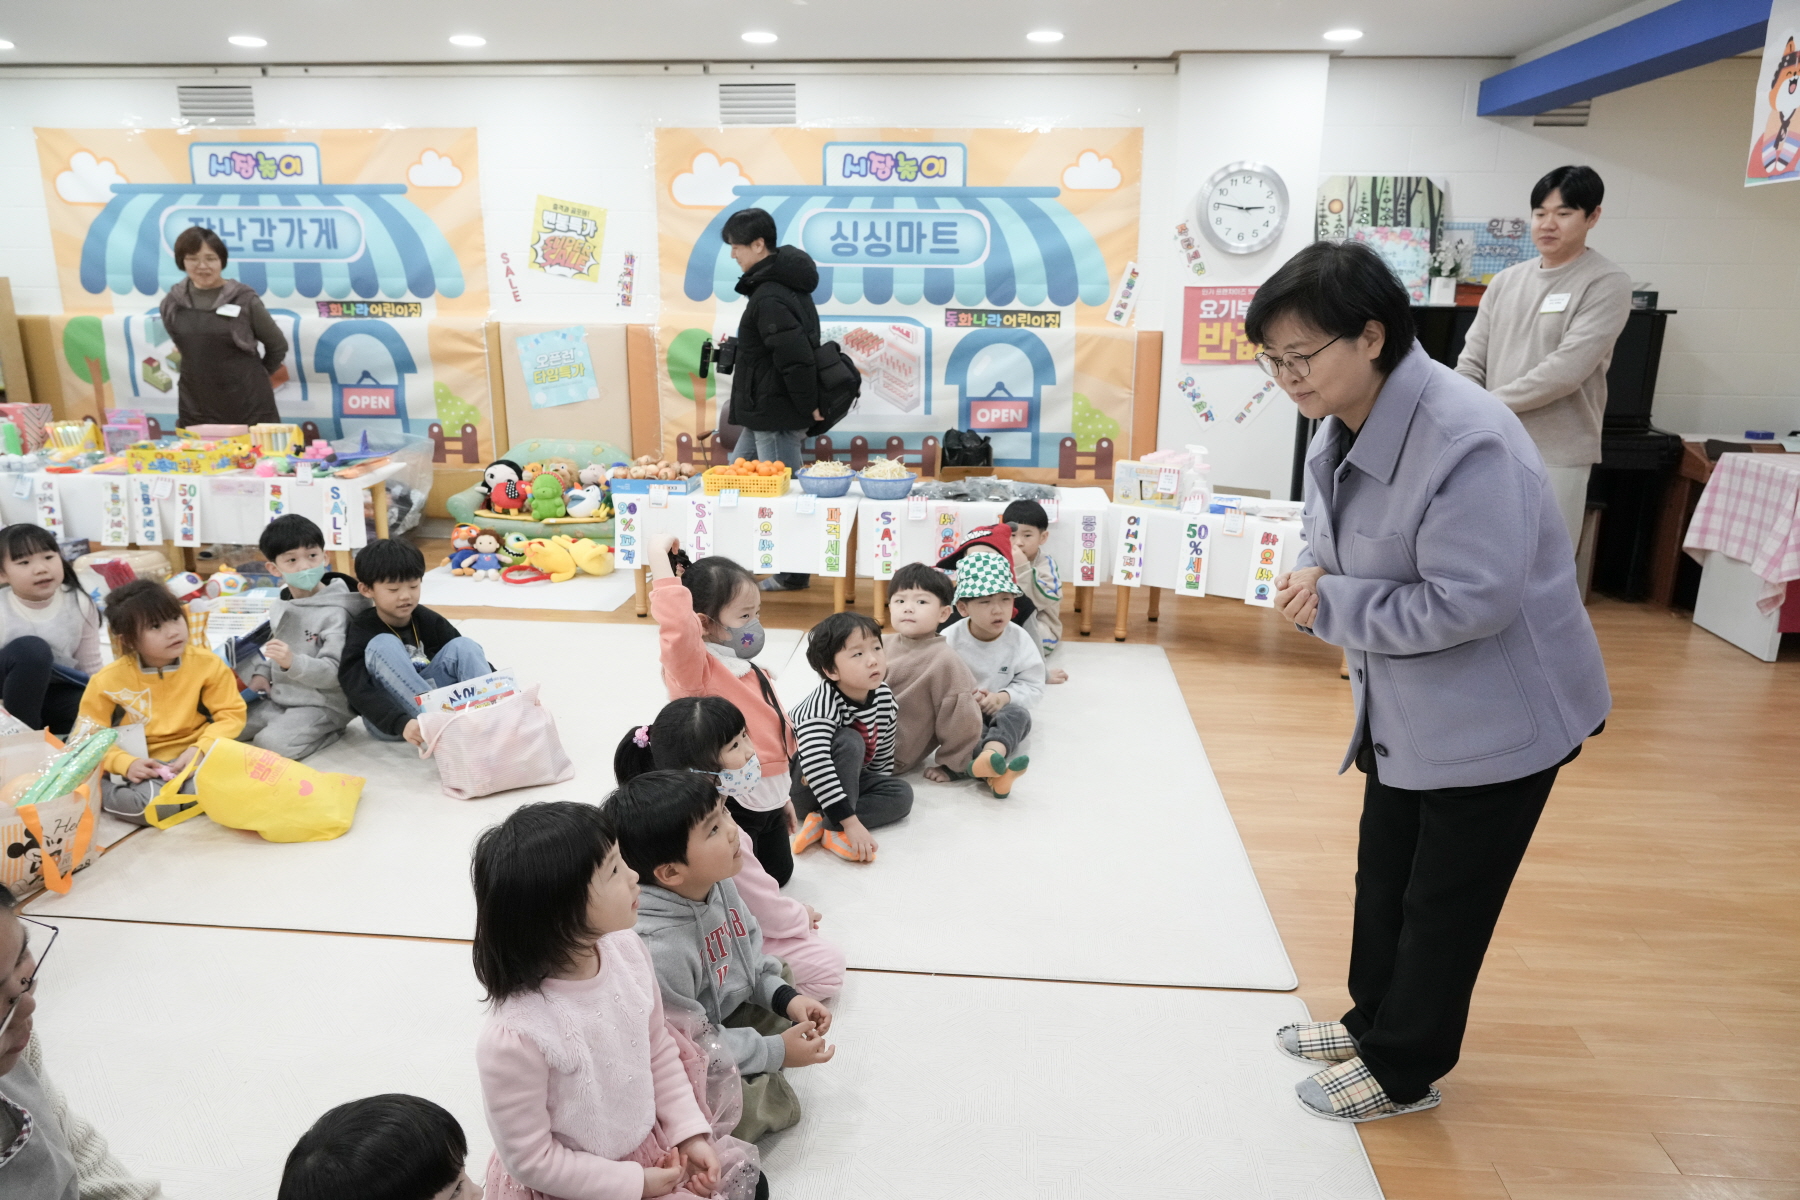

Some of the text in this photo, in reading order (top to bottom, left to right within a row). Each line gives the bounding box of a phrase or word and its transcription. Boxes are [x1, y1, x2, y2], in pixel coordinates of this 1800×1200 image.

[209, 151, 303, 180] 시장놀이
[842, 151, 947, 182] 시장놀이
[1230, 178, 1238, 186] 11
[1242, 175, 1252, 184] 12
[1219, 188, 1228, 196] 10
[1266, 190, 1274, 199] 2
[1213, 202, 1220, 211] 9
[1268, 205, 1276, 214] 3
[1215, 217, 1222, 225] 8
[1225, 227, 1231, 236] 7
[1262, 220, 1269, 228] 4
[830, 220, 960, 257] 싱싱마트
[1237, 232, 1244, 241] 6
[1251, 229, 1259, 238] 5
[541, 236, 595, 257] SUPER
[539, 248, 590, 272] SALE
[501, 252, 521, 302] SALE
[536, 348, 576, 369] 오픈런
[533, 363, 585, 384] 타임특가
[348, 394, 390, 409] OPEN
[1234, 381, 1275, 424] SALE
[976, 408, 1023, 422] OPEN
[330, 486, 343, 545] SALE
[758, 507, 774, 568] 싸요싸요
[825, 508, 841, 572] 파격세일
[880, 511, 893, 573] SALE
[1080, 516, 1097, 581] 몽땅세일
[1255, 532, 1278, 600] 싸요싸요
[249, 750, 283, 782] 행복
[54, 812, 85, 835] Hel
